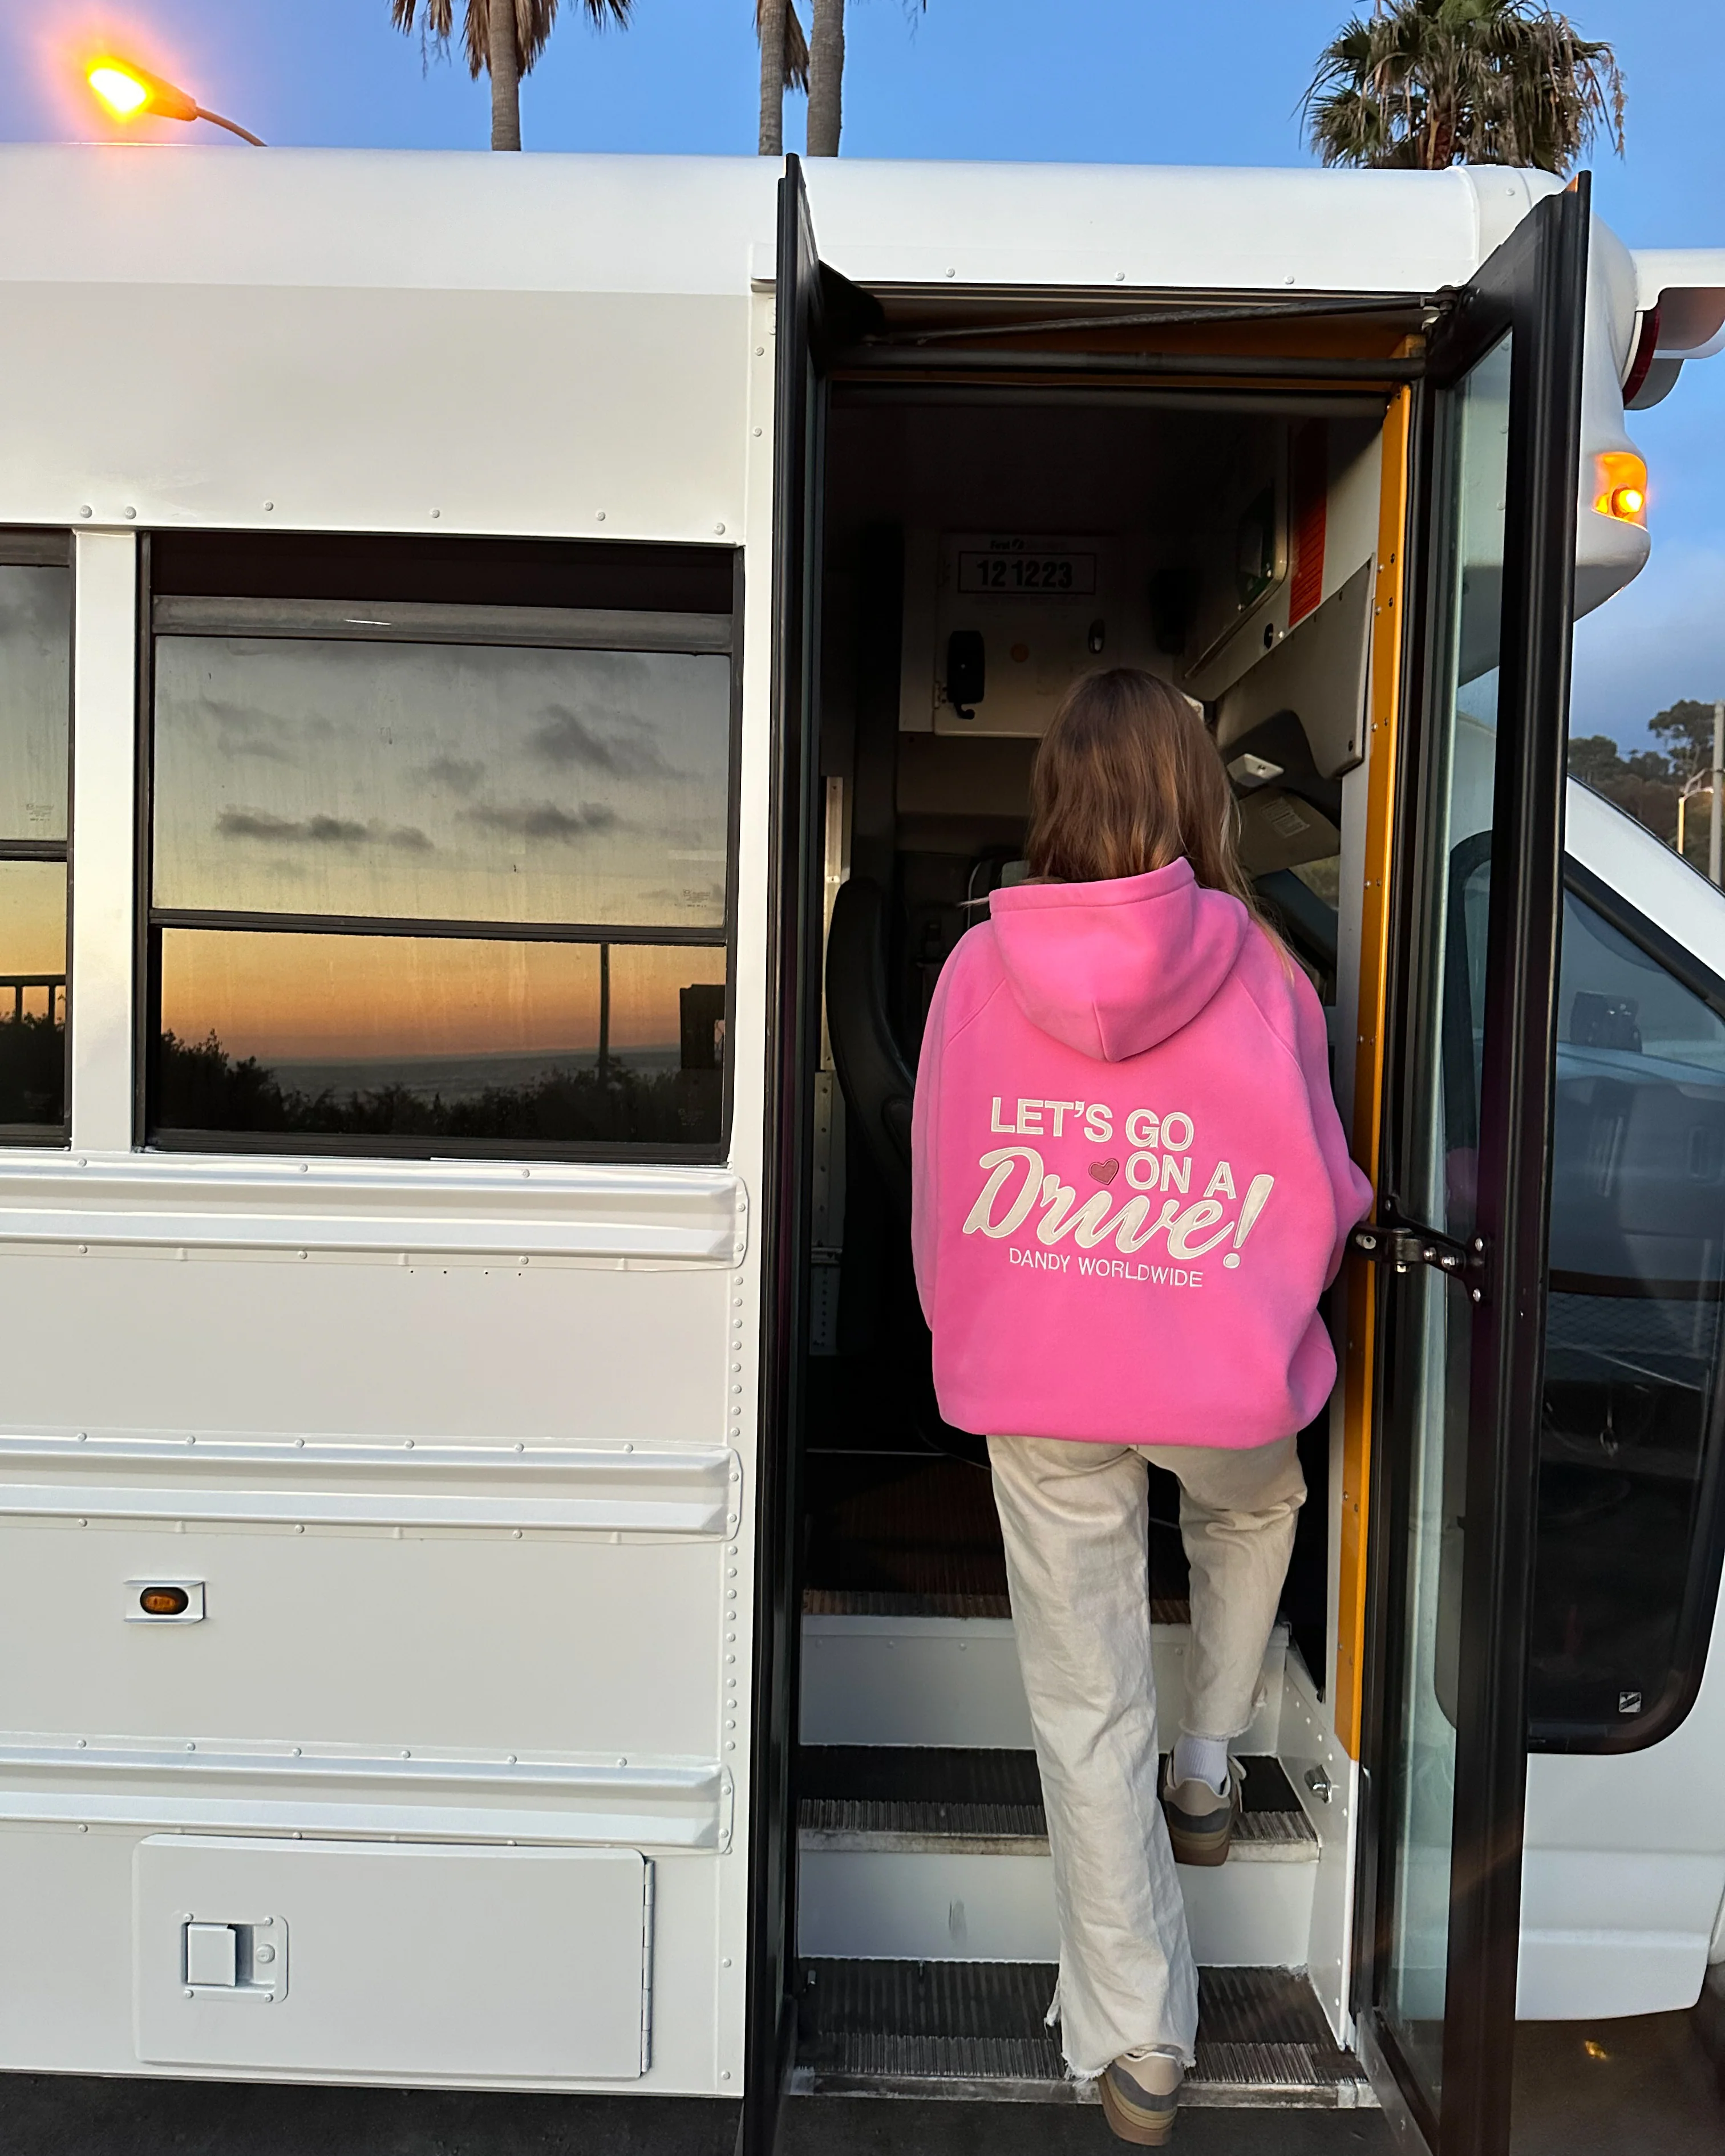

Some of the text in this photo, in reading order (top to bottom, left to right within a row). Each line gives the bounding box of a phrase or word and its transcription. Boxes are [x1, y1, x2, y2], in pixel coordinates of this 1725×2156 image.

[977, 560, 1073, 589] 121223
[991, 1097, 1194, 1152] LET'S GO
[1125, 1150, 1237, 1199] ON A
[962, 1146, 1275, 1269] Drive!
[1009, 1247, 1203, 1287] DANDY WORLDWIDE
